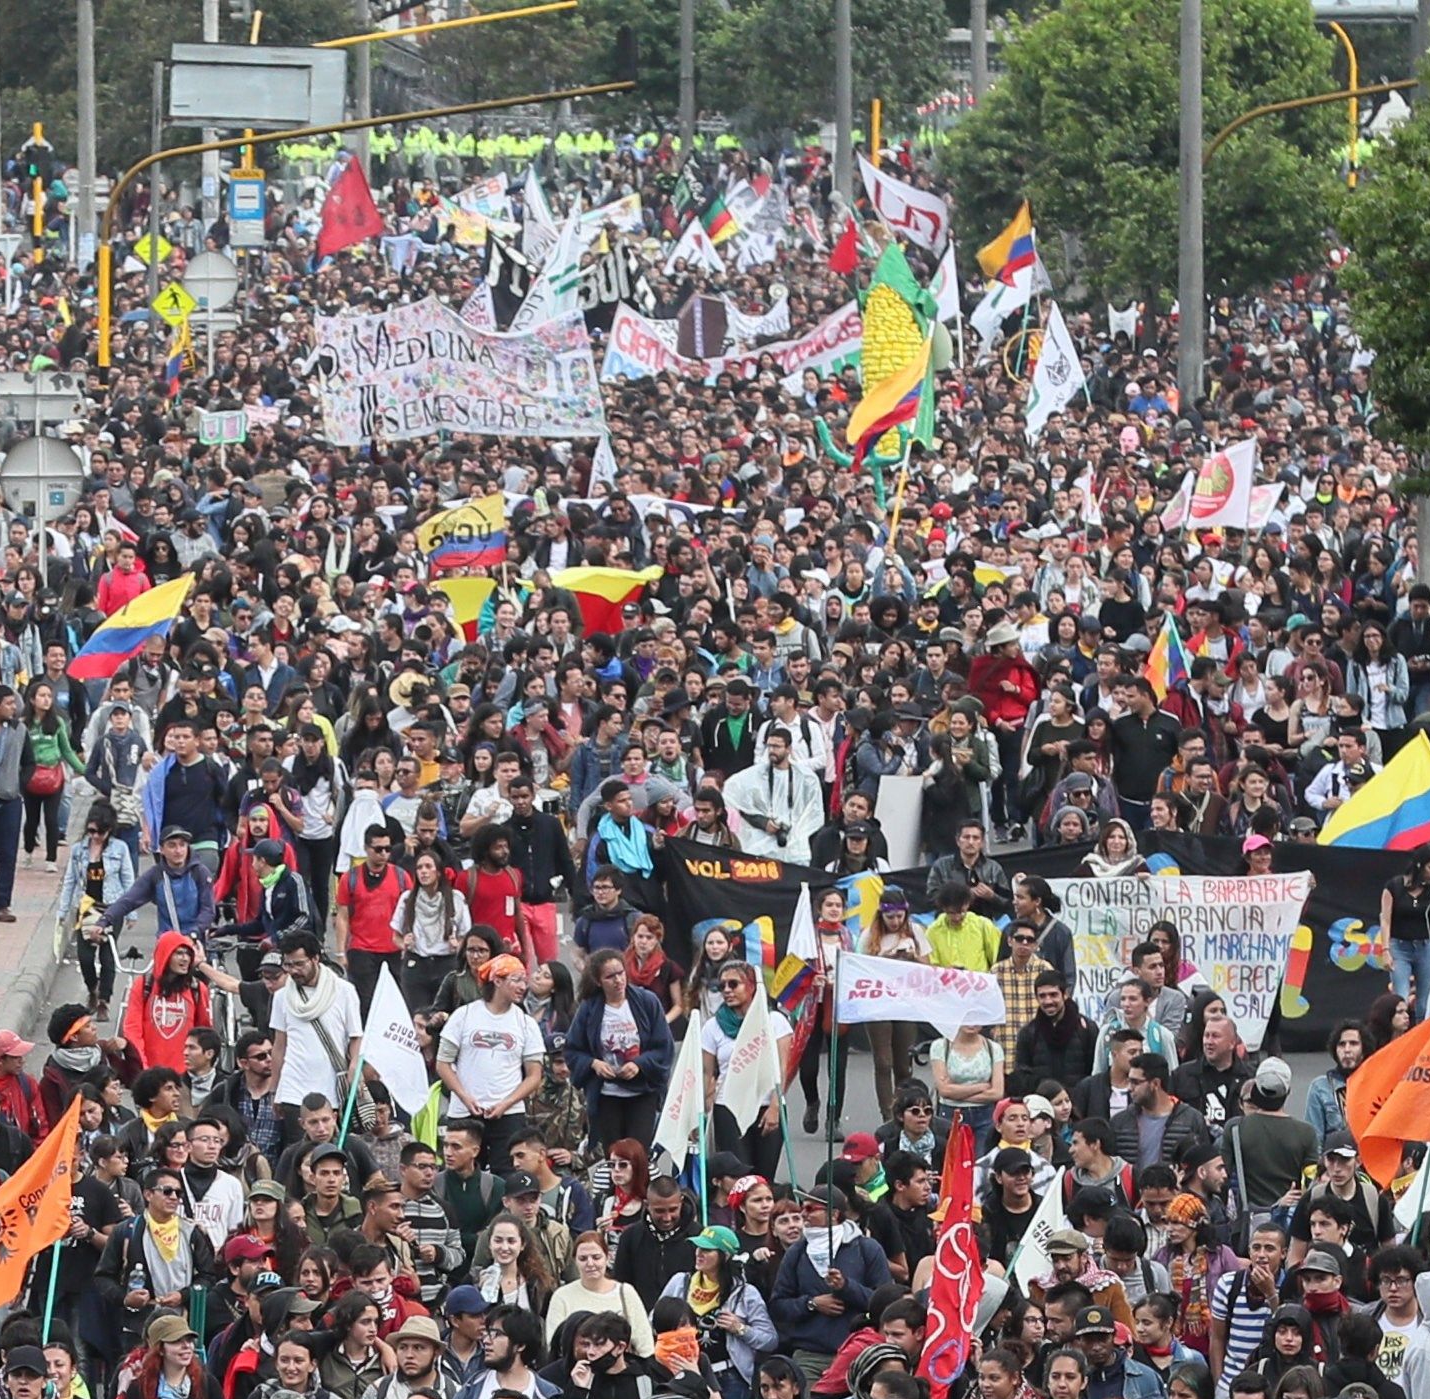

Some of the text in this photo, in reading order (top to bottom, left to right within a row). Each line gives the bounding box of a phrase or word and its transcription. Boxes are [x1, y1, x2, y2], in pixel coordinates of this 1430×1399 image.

[351, 320, 503, 376] MEDICINA
[382, 395, 543, 435] SEMESTRE
[1065, 876, 1304, 908] CONTRA LA BARBARIE
[1069, 905, 1265, 936] Y LA IGNORANCIA
